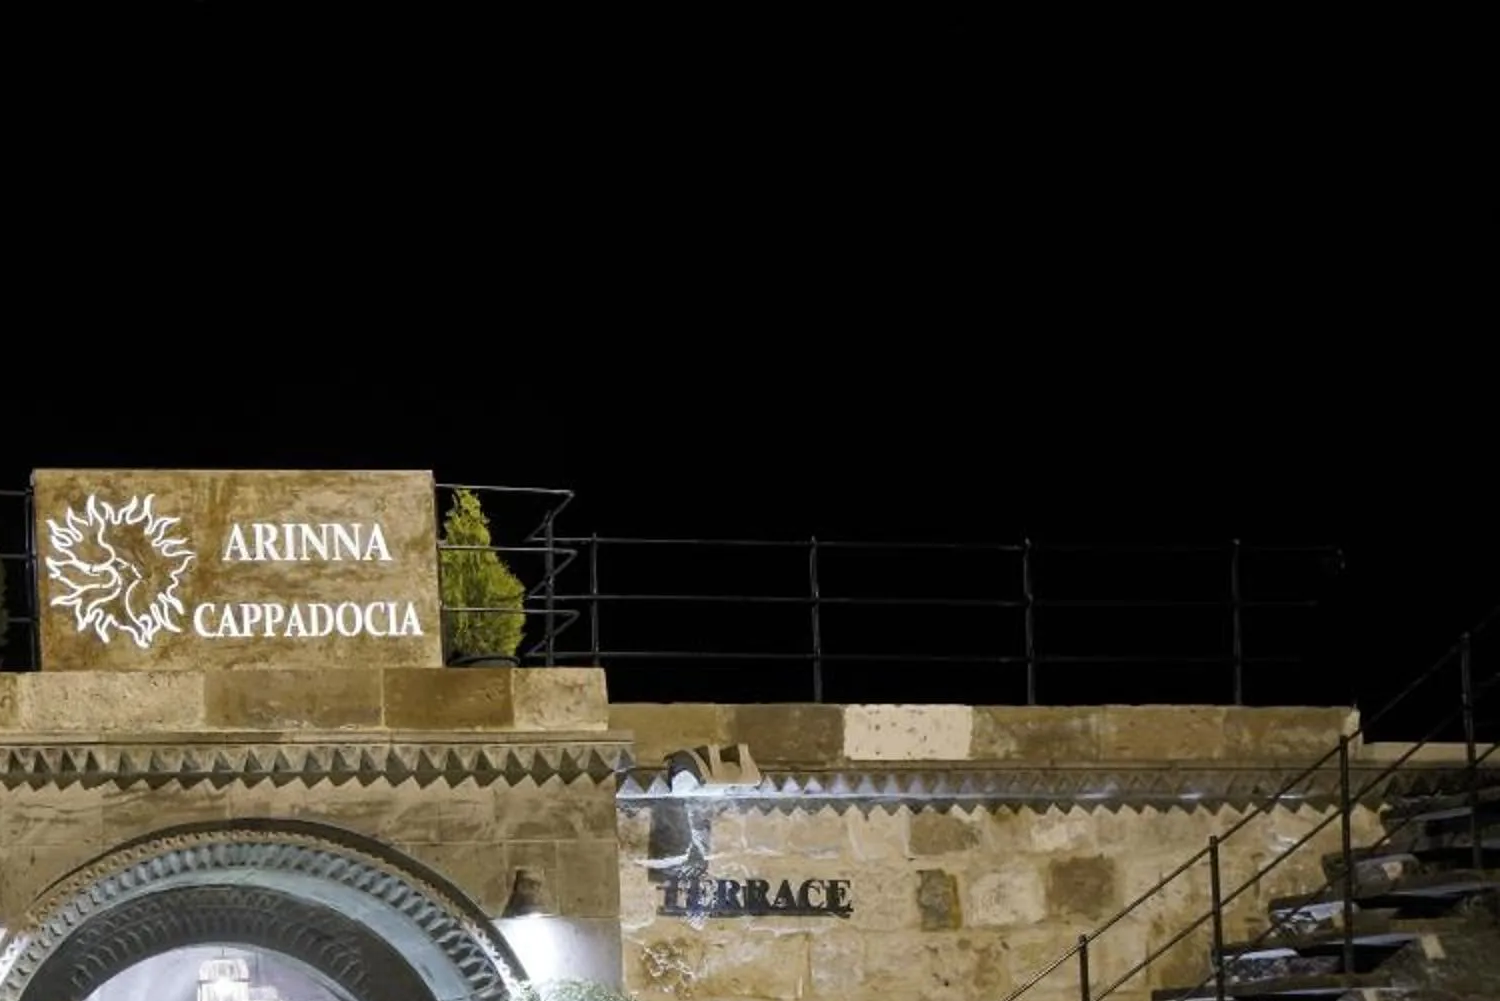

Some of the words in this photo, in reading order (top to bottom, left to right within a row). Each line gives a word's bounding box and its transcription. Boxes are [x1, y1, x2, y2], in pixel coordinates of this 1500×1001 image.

[222, 522, 393, 562] ARINNA
[192, 601, 424, 638] CAPPADOCIA
[657, 878, 853, 917] TERRACE
